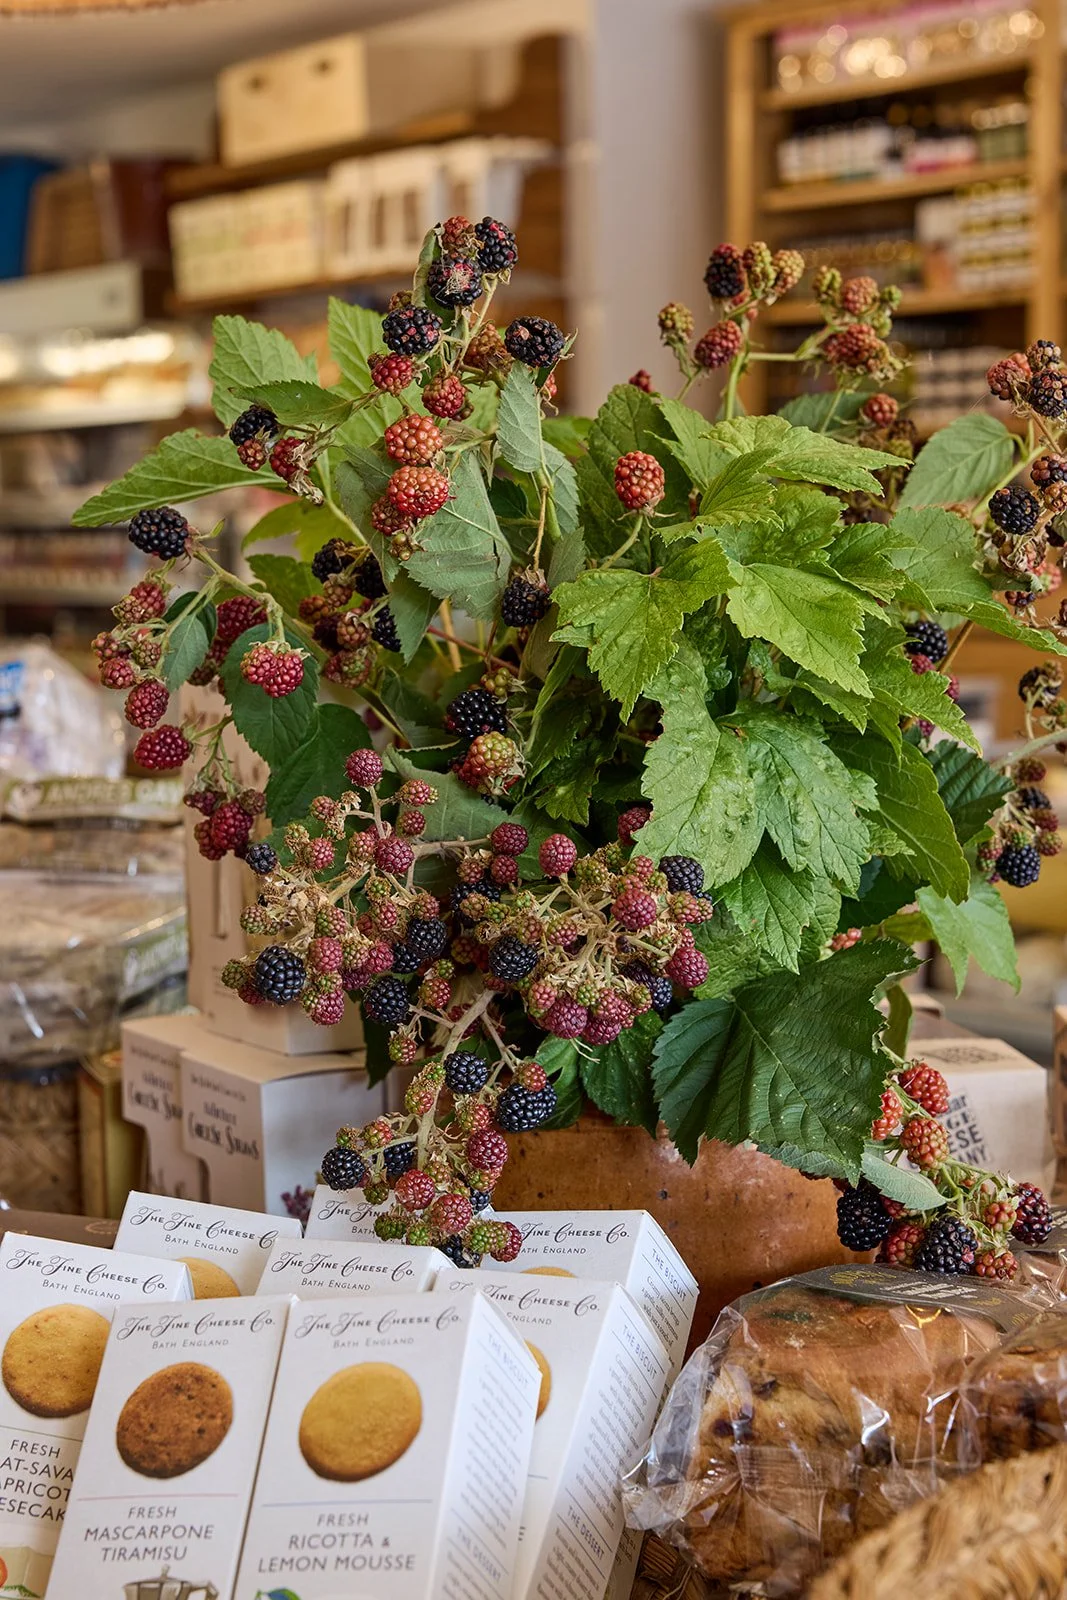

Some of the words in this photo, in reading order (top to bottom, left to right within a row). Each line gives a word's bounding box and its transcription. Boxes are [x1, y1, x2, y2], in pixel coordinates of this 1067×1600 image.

[948, 1124, 983, 1153] ESE
[258, 1230, 279, 1249] C
[10, 1439, 61, 1459] FRESH
[0, 1456, 74, 1482] AT-SAVA
[0, 1496, 66, 1521] ESECAK
[128, 1506, 177, 1519] FRESH
[317, 1513, 369, 1527] FRESH
[84, 1524, 215, 1542] MASCARPONE
[288, 1533, 373, 1550] RICOTTA
[381, 1536, 391, 1548] &
[101, 1546, 188, 1562] TIRAMISU
[258, 1556, 328, 1573] LEMON
[334, 1554, 416, 1572] MOUSSE
